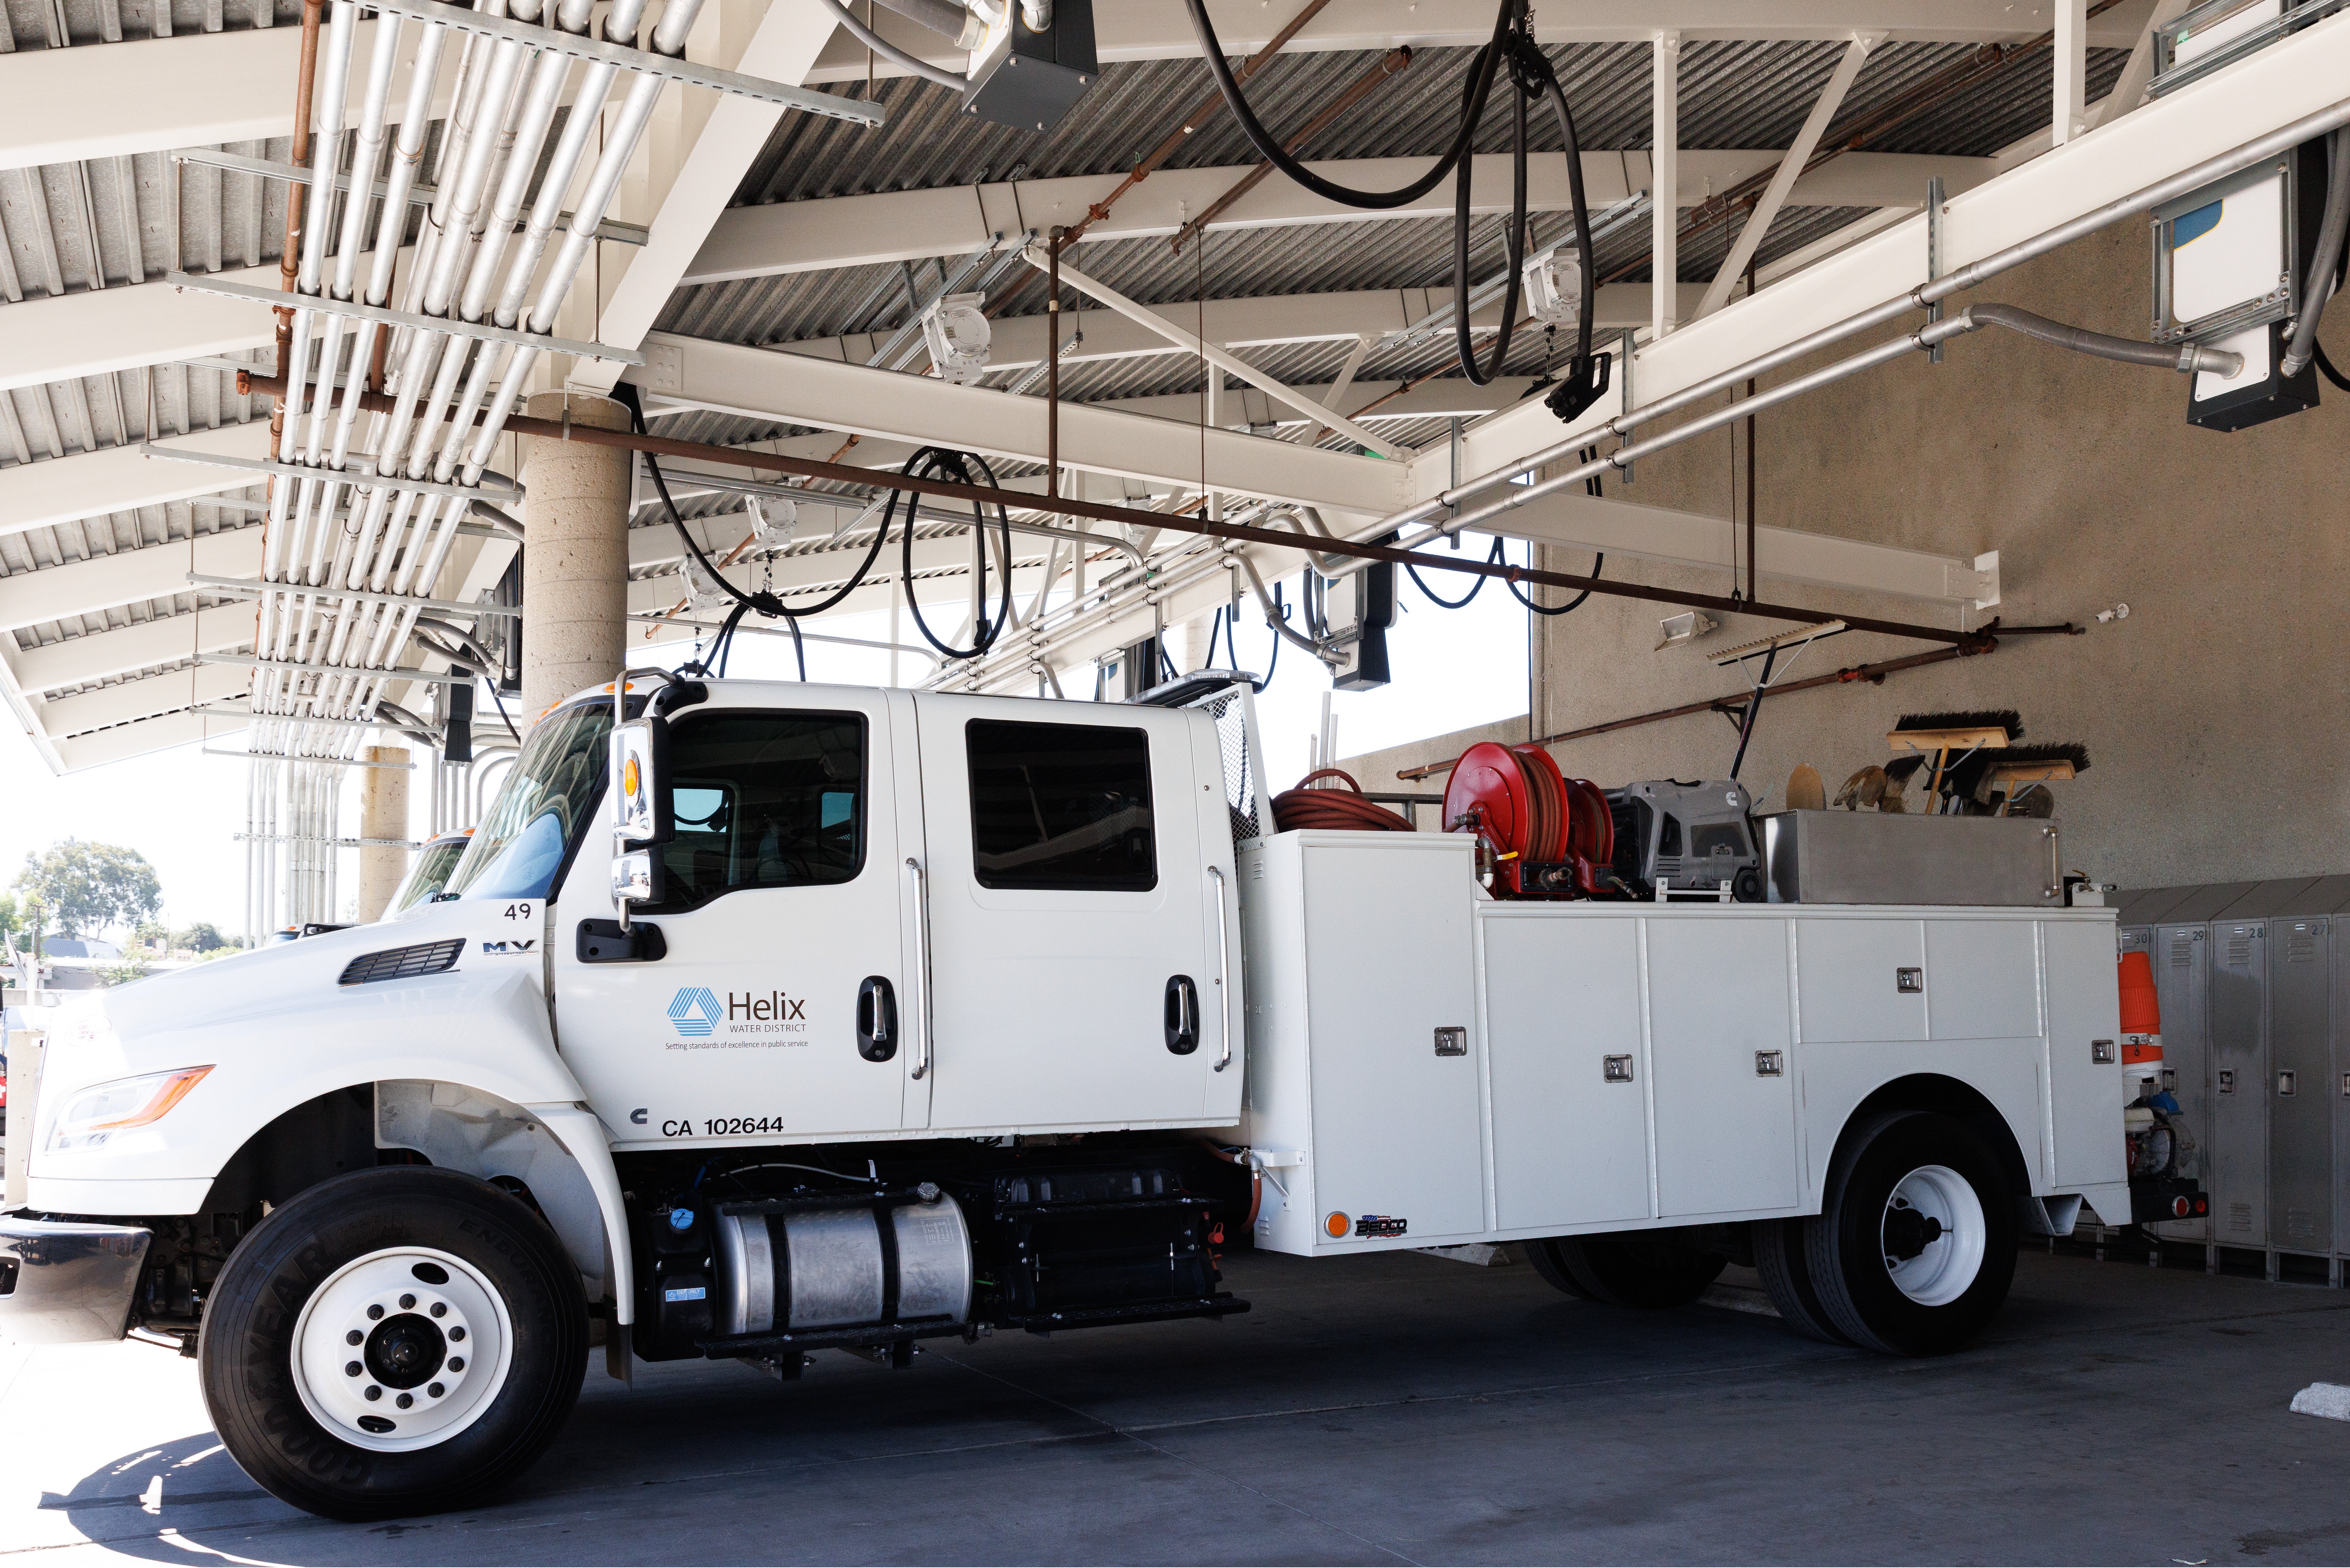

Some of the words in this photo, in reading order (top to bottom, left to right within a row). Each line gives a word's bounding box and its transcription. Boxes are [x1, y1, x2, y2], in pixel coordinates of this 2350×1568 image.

[504, 903, 531, 920] 49
[2192, 931, 2204, 941] 29
[2249, 928, 2263, 938] 28
[2312, 925, 2326, 935] 27
[2135, 934, 2147, 944] 30
[483, 939, 537, 954] MV
[729, 990, 806, 1020] Helix
[765, 1024, 806, 1032] DISTRICT
[665, 1041, 687, 1051] Setting
[768, 1040, 786, 1049] public
[662, 1120, 693, 1137] CA
[704, 1117, 784, 1135] 102644
[1356, 1219, 1407, 1232] BEDCO
[247, 1242, 374, 1486] GOODYEAR
